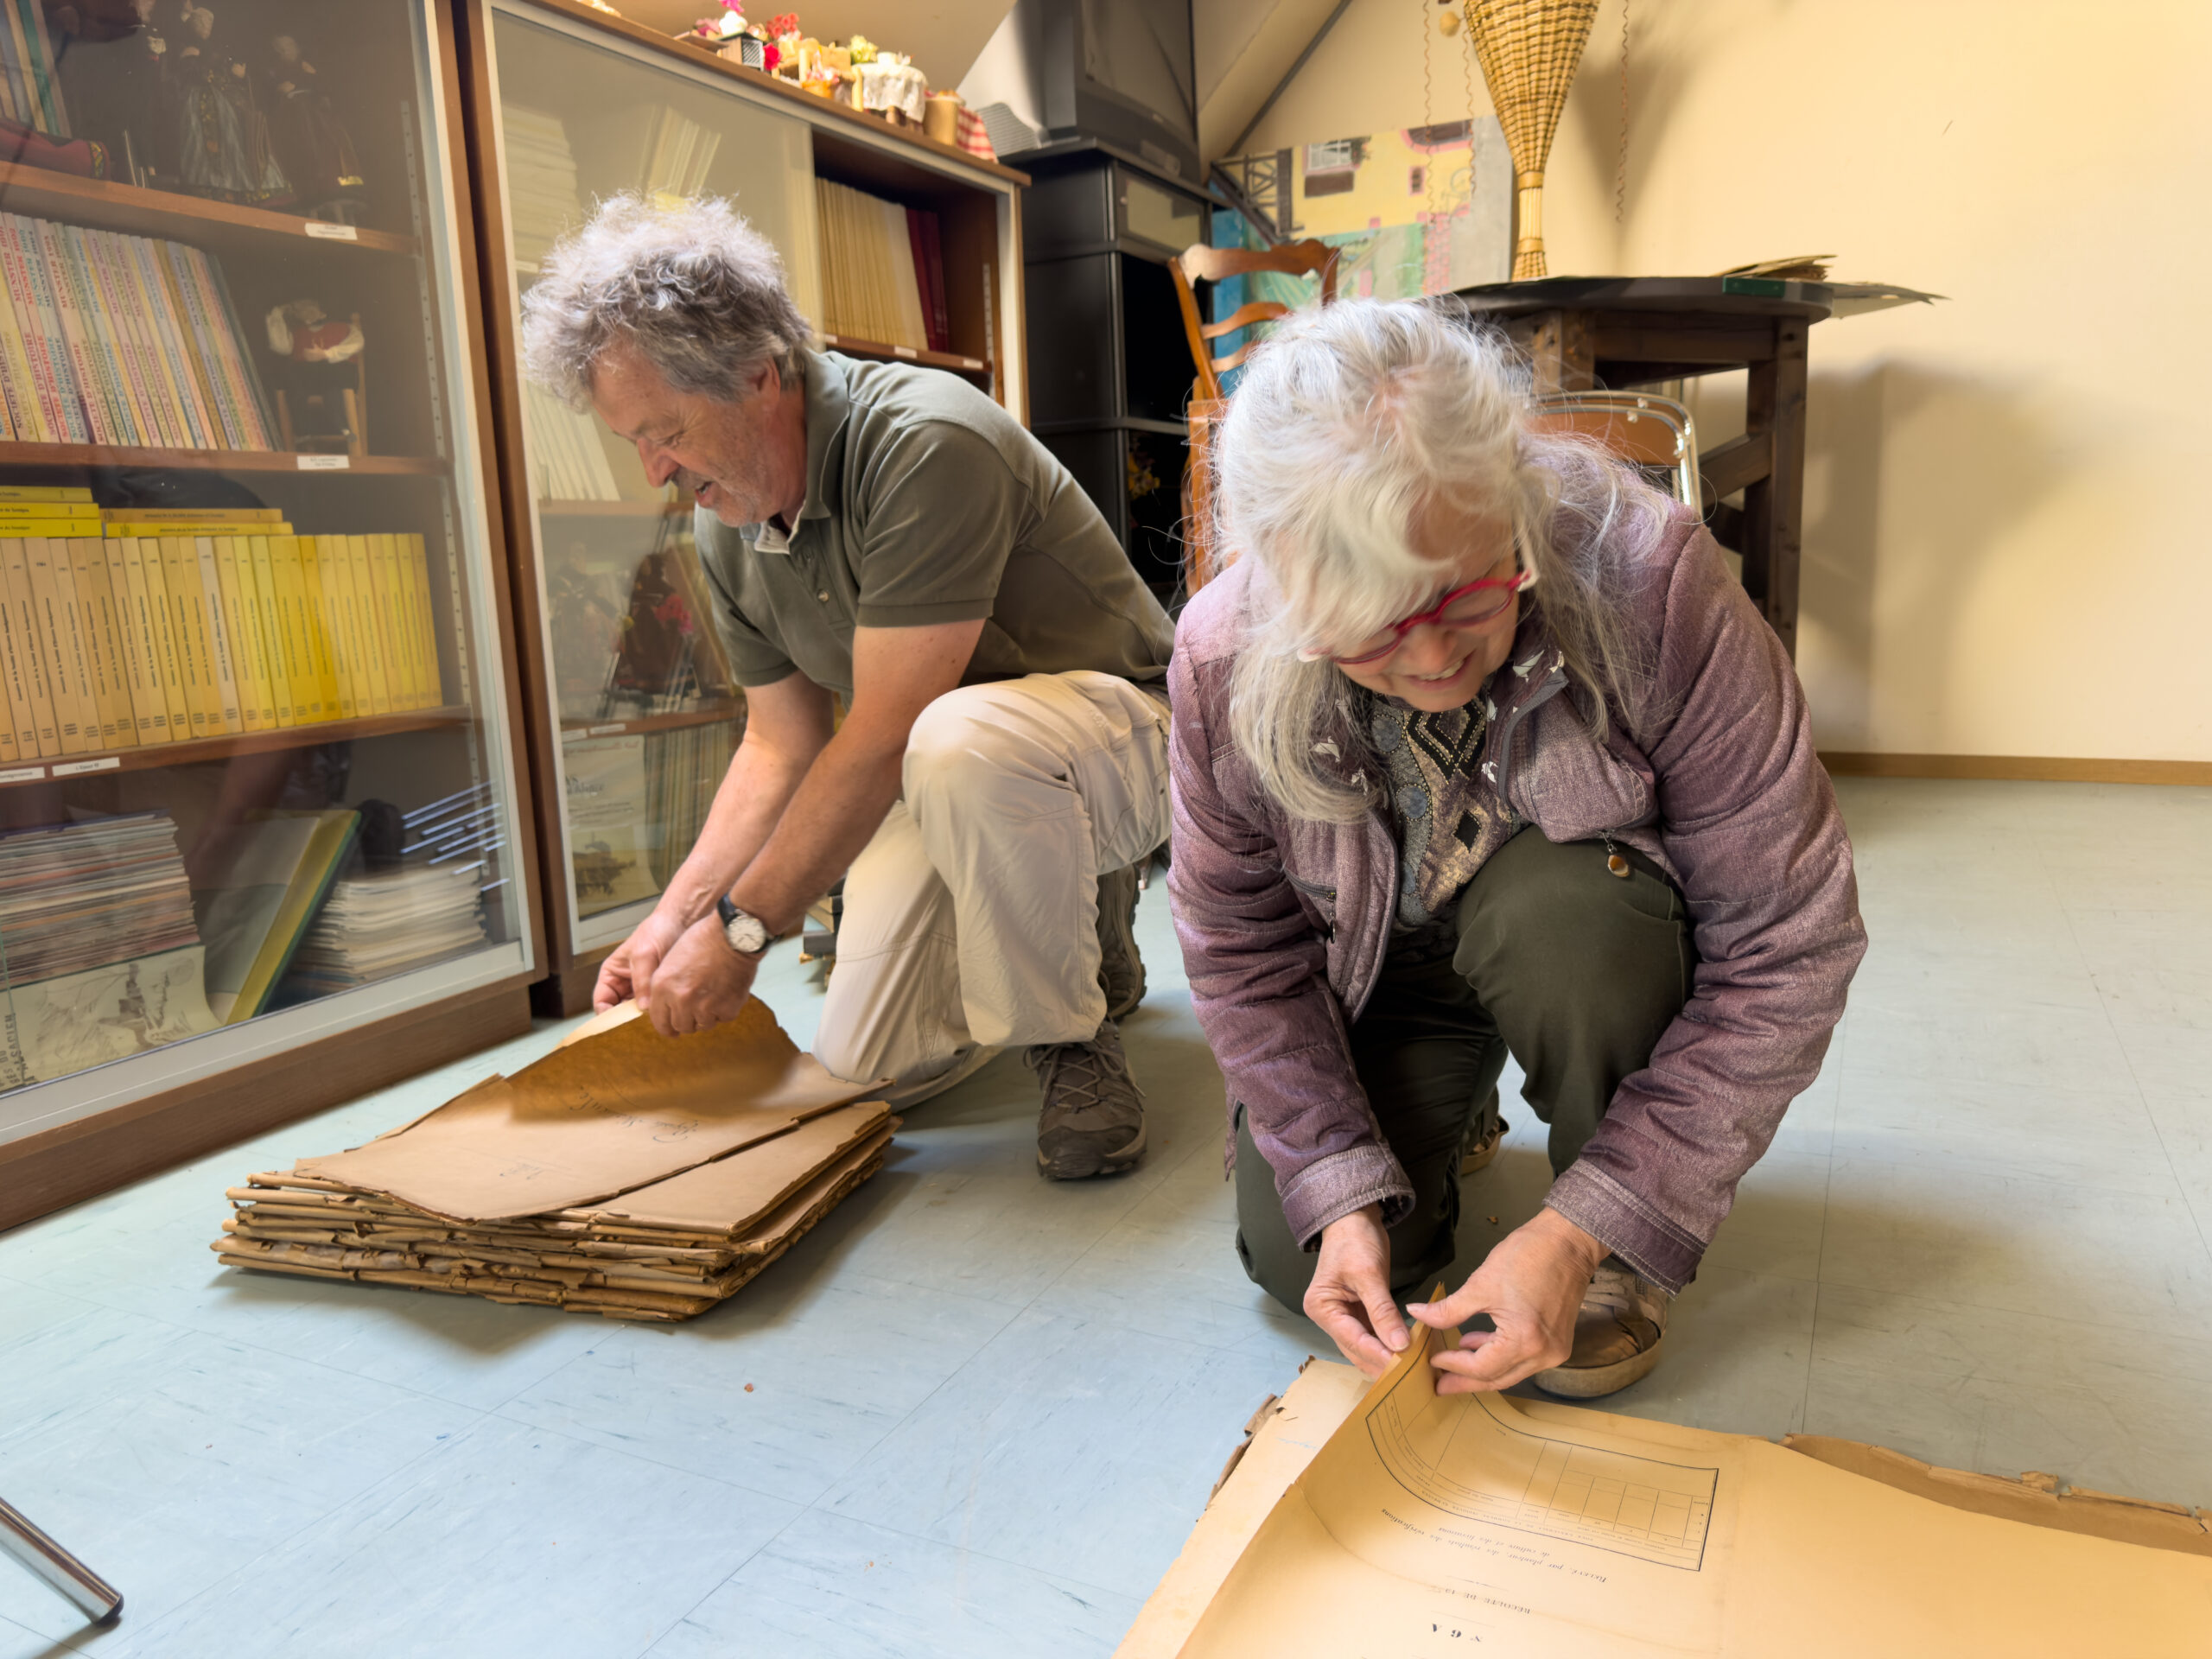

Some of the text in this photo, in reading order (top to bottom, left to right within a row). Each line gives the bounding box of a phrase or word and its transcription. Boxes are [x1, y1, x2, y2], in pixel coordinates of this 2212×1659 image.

[3, 251, 22, 302] MUNSTER
[16, 255, 33, 304] MUNSTER
[26, 257, 42, 307] MUNSTER
[35, 257, 51, 308] MUNSTER
[49, 259, 67, 308] MUNSTER
[23, 331, 44, 391] D'HISTOIRE
[36, 334, 57, 392] D'HISTOIRE
[39, 393, 56, 435] SOCIETE
[1380, 1508, 1425, 1535] vérifications
[1431, 1624, 1442, 1632] A
[1451, 1629, 1462, 1638] 6
